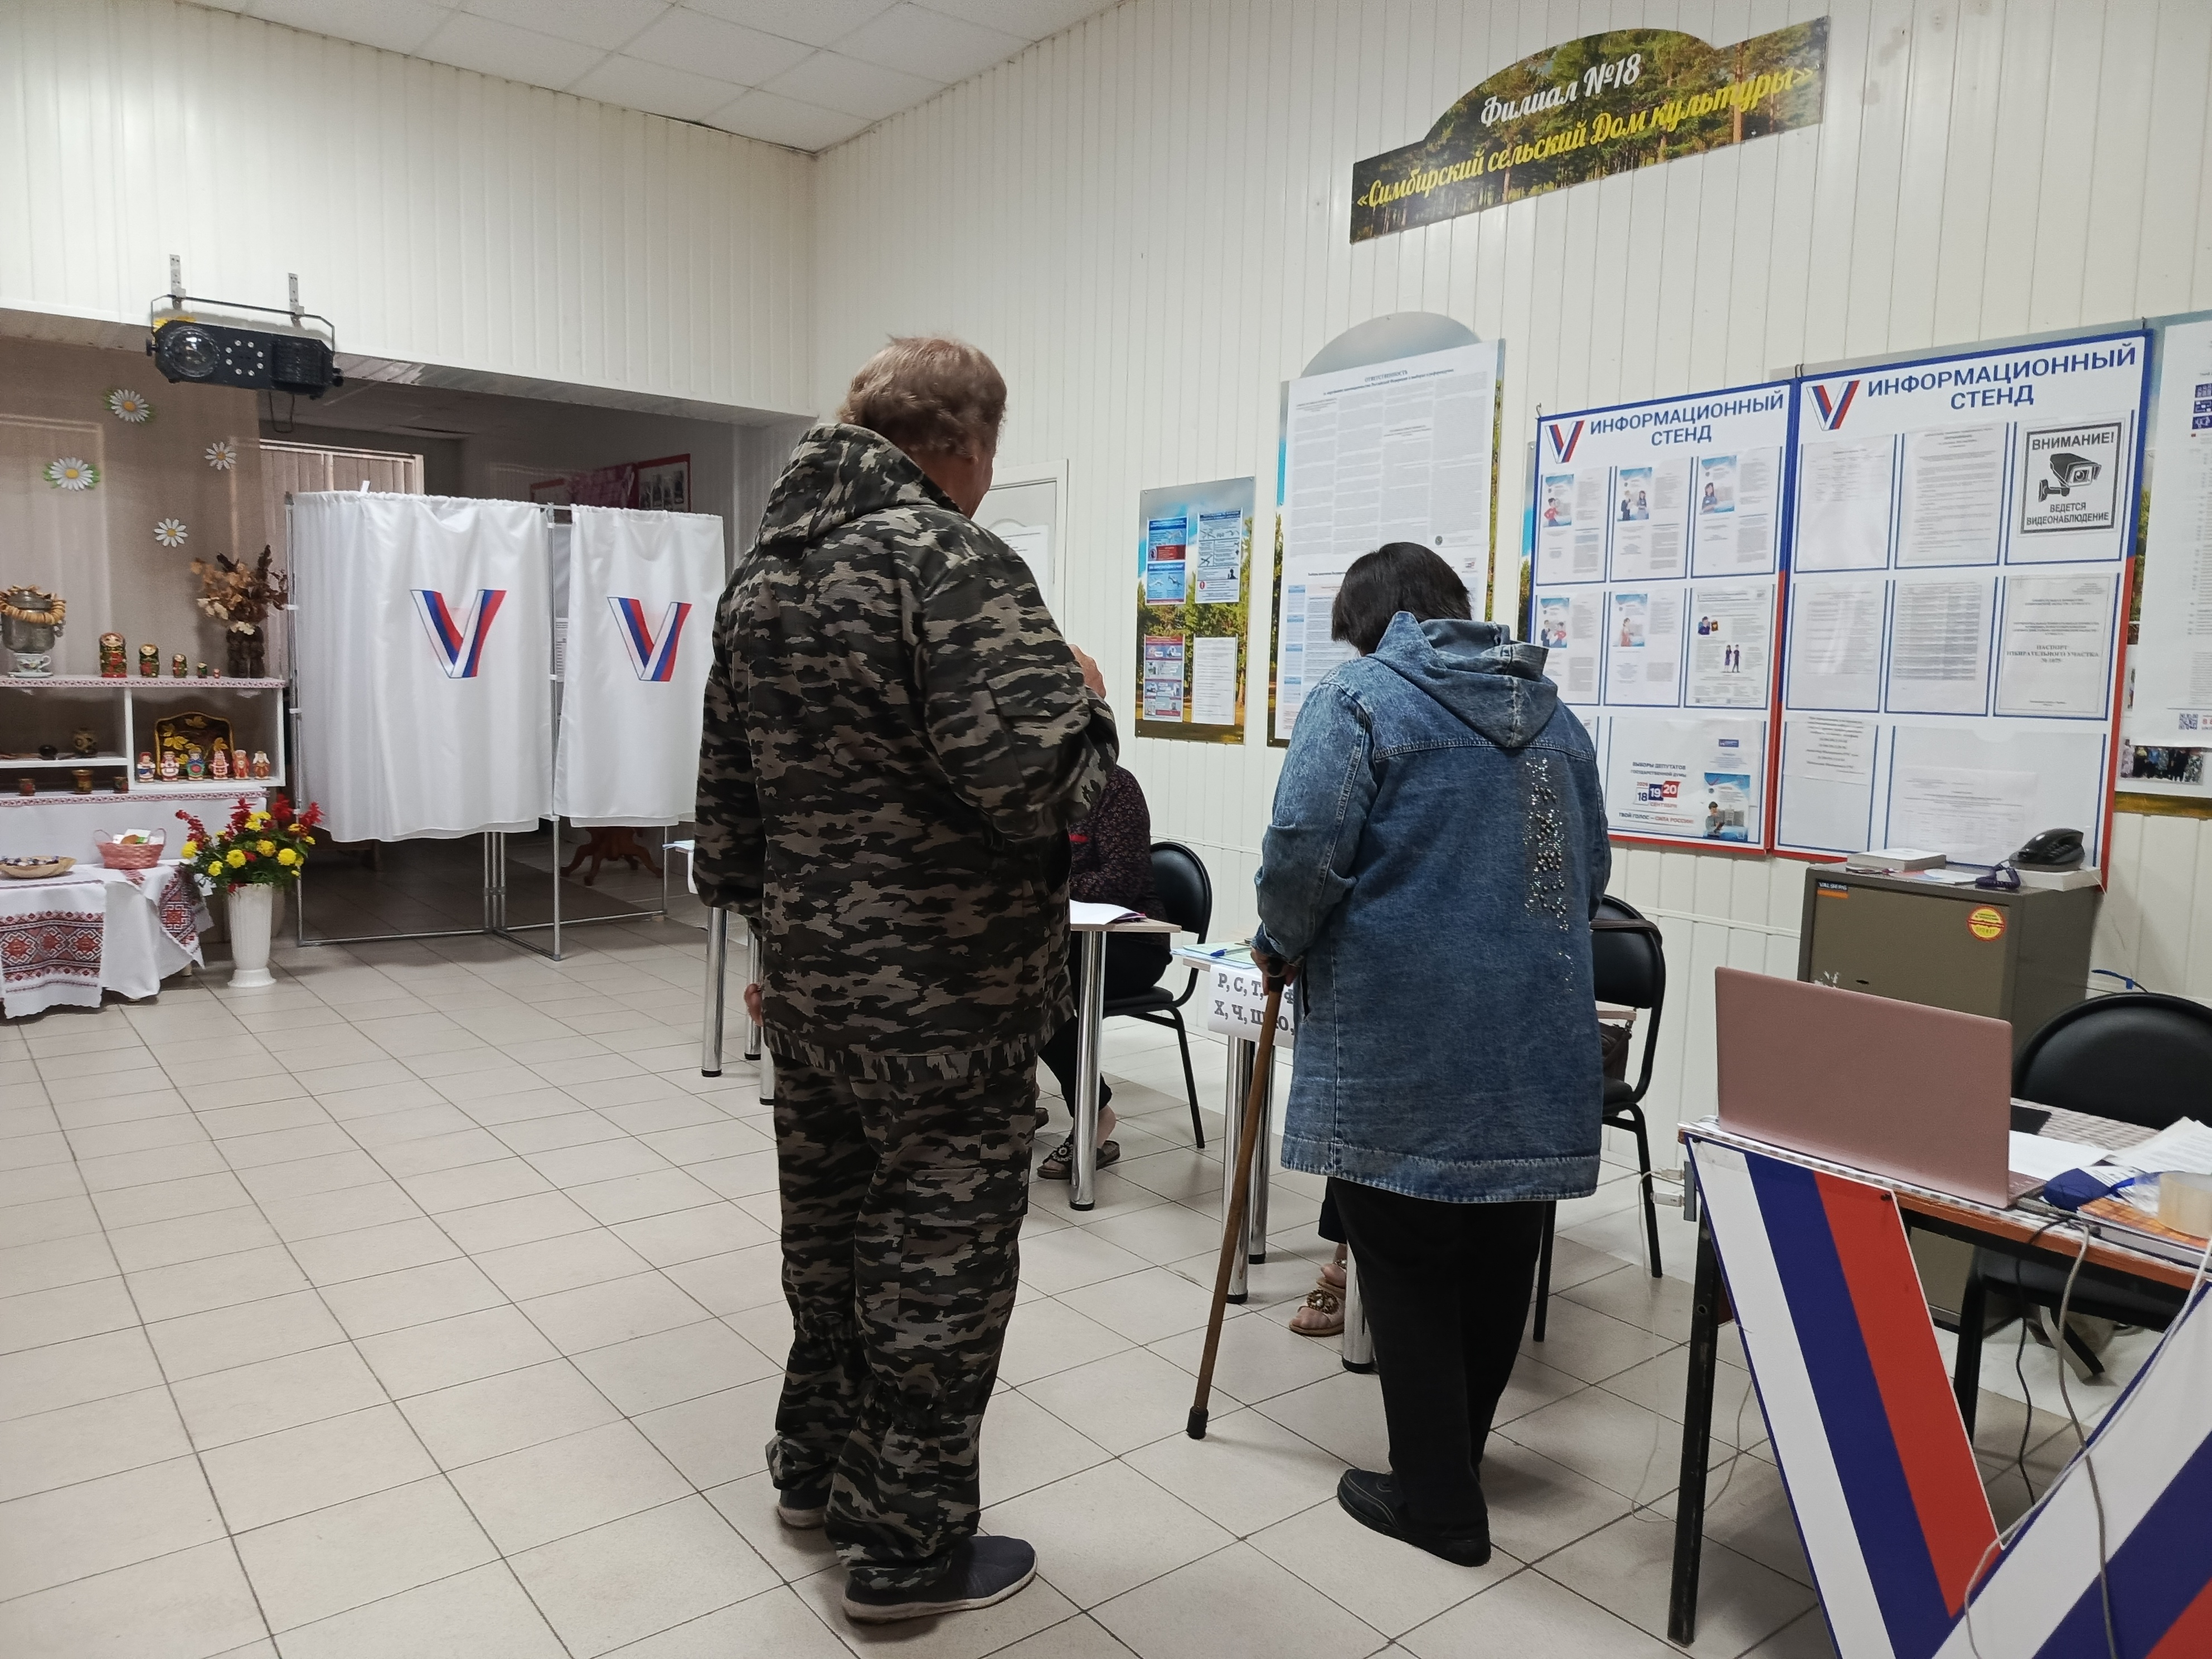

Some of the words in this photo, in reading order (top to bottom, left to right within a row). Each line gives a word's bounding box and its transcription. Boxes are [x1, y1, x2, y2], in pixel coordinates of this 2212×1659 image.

[1481, 81, 1578, 127] Филиал
[1584, 54, 1641, 97] №18
[1357, 151, 1485, 207] «Симбирский
[1487, 119, 1587, 172] сельский
[1590, 110, 1647, 145] Дом
[1651, 67, 1813, 132] культуры»
[1867, 342, 2136, 396] ИНФОРМАЦИОННЫЙ
[1951, 385, 2034, 410] СТЕНД
[1590, 390, 1784, 435] ИНФОРМАЦИОННЫЙ
[1651, 425, 1711, 446] СТЕНД
[2032, 431, 2114, 450] ВНИМАНИЕ!
[2026, 512, 2109, 526] ВИДЕОНАБЛЮДЕНИЕ
[2050, 502, 2086, 513] ВЕДЕТСЯ
[1637, 792, 1647, 802] 18
[1650, 788, 1661, 798] 19
[1663, 784, 1677, 794] 20
